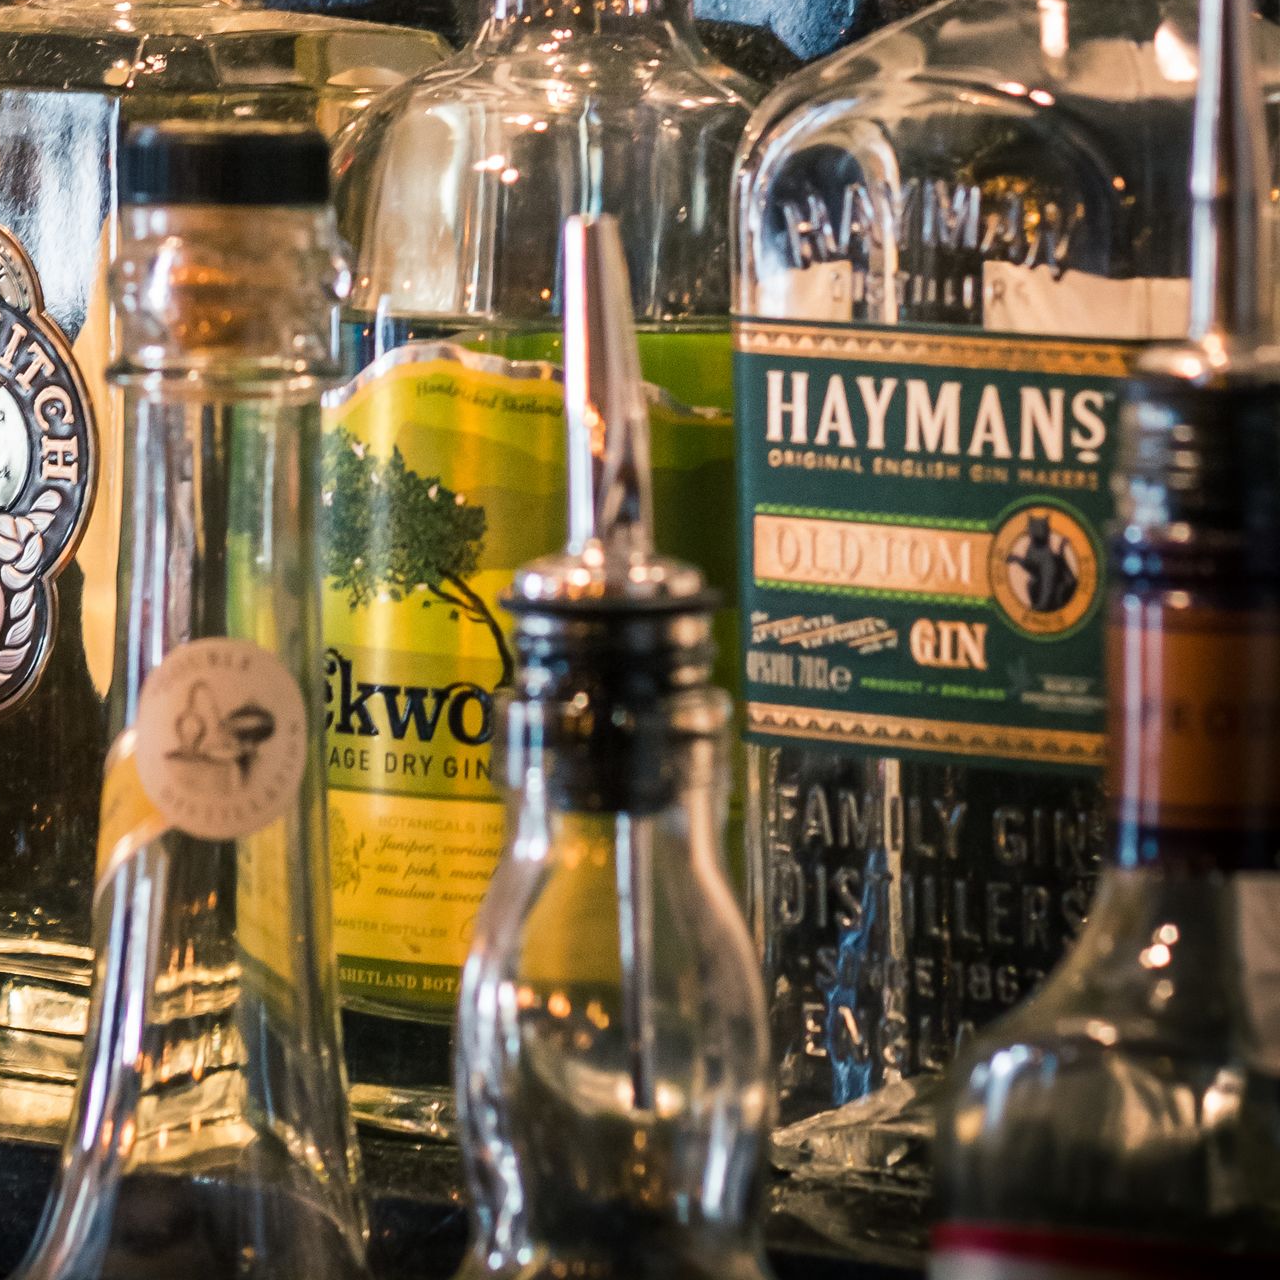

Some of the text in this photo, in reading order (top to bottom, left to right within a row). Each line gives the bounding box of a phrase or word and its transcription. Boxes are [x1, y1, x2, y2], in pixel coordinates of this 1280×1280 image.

[766, 370, 1106, 464] HAYMANS
[768, 448, 864, 474] ORIGINAL
[873, 456, 962, 481] ENGLISH
[970, 463, 1010, 484] GIN
[776, 524, 864, 579] OLD
[871, 530, 971, 585] TOM
[910, 617, 989, 671] GIN
[328, 745, 370, 772] AGE
[384, 751, 434, 778] DRY
[339, 967, 417, 990] SHETLAND
